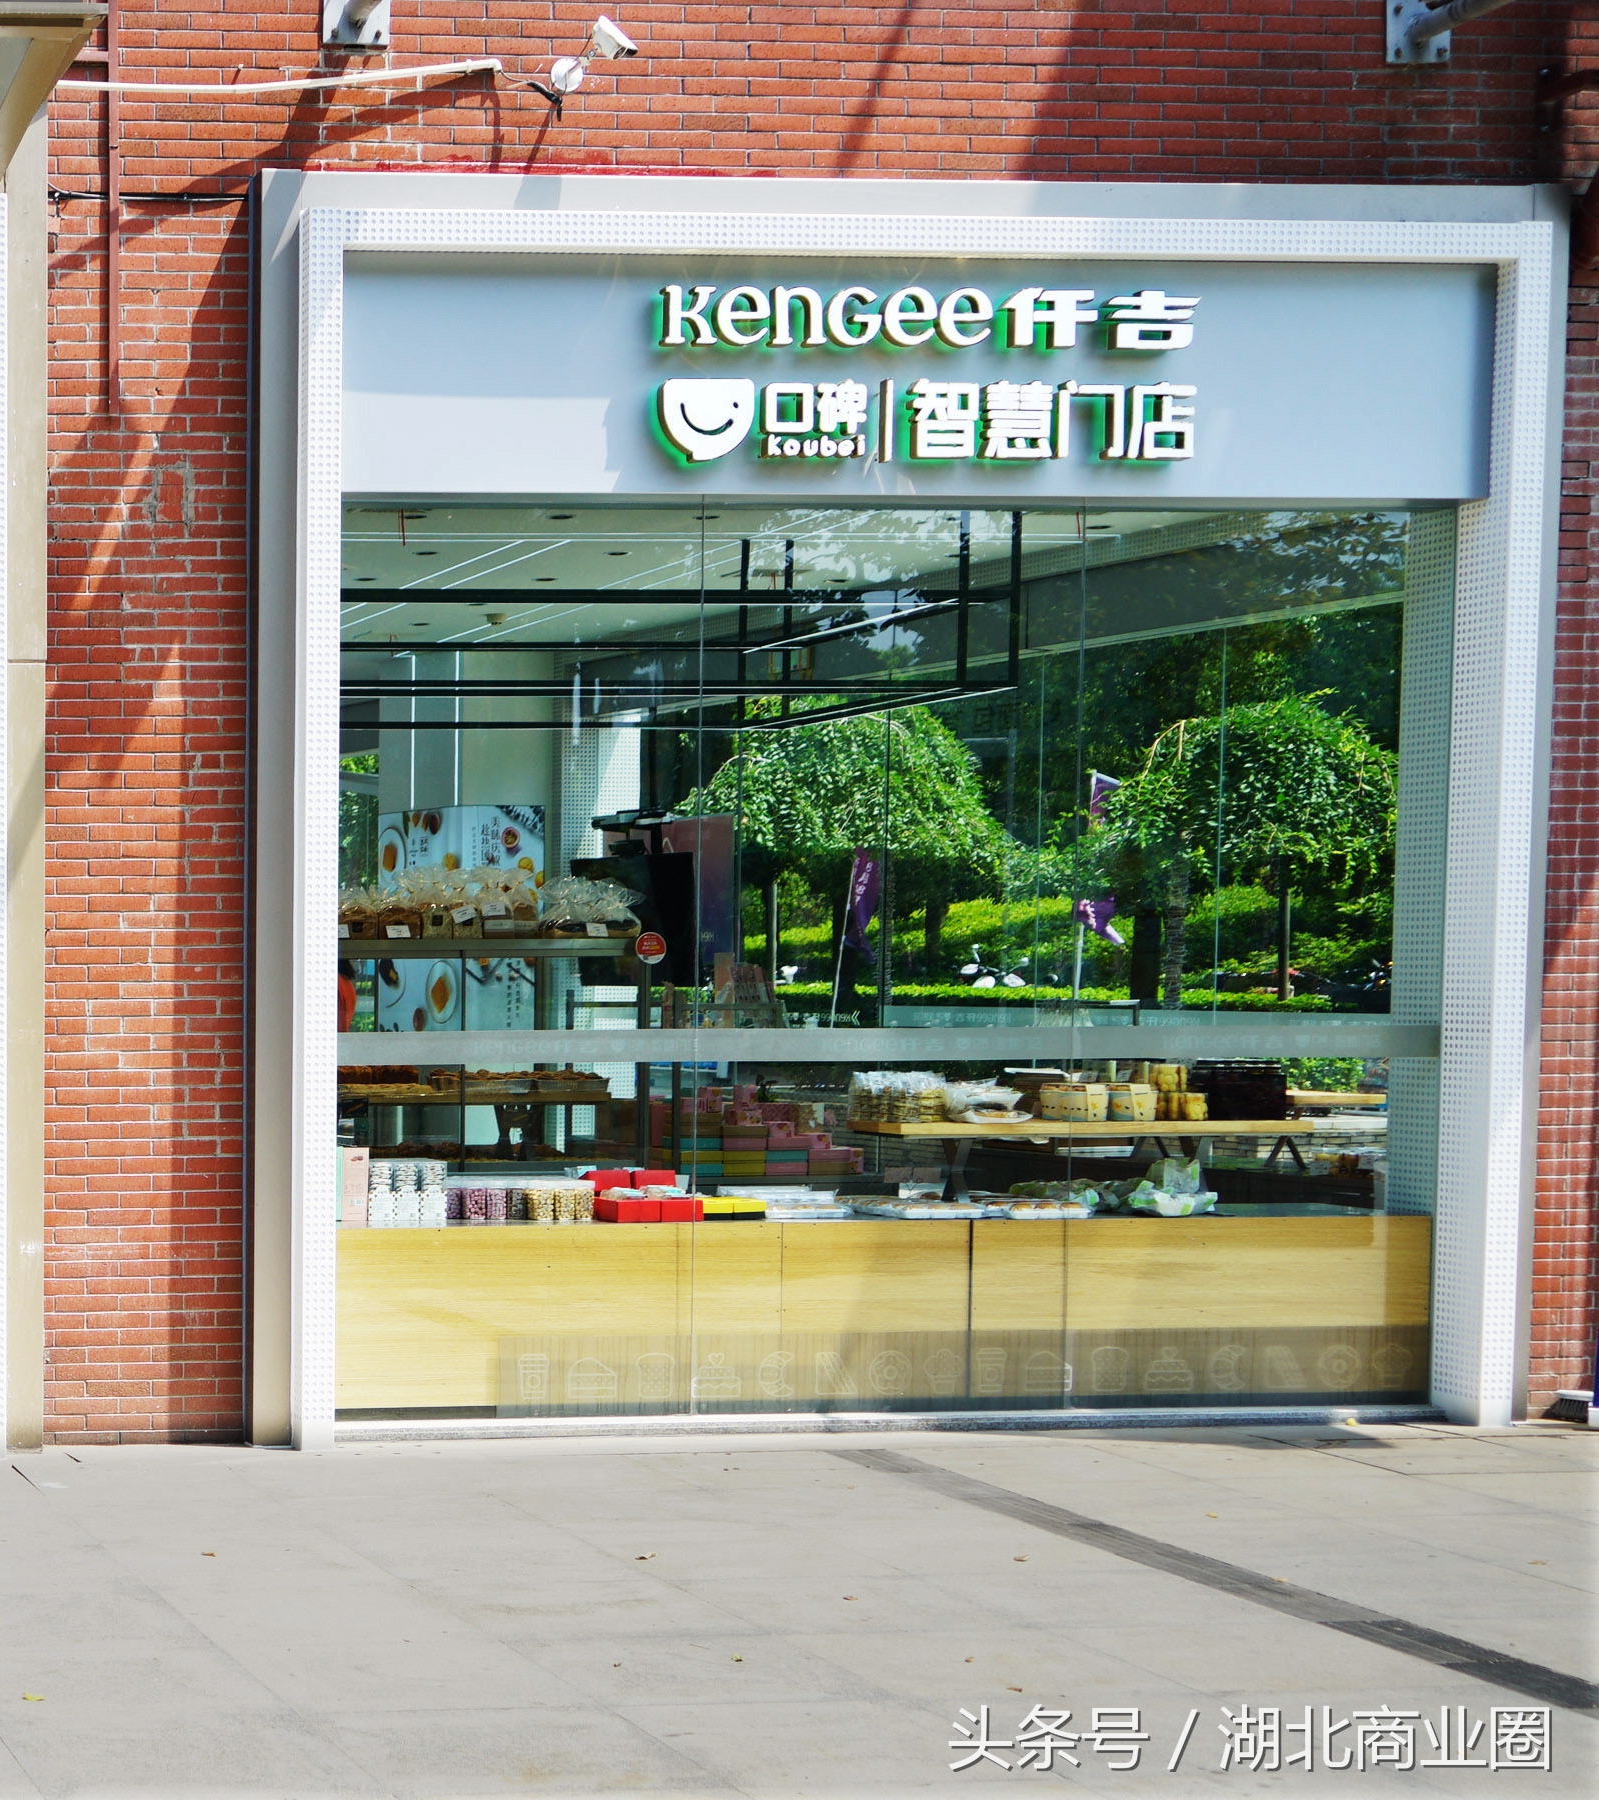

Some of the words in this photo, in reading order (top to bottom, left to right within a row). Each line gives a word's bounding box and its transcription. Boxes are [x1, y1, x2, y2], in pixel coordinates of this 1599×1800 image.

[1003, 287, 1202, 350] 仟吉
[762, 379, 868, 435] 口碑
[908, 378, 1197, 460] 智慧门店
